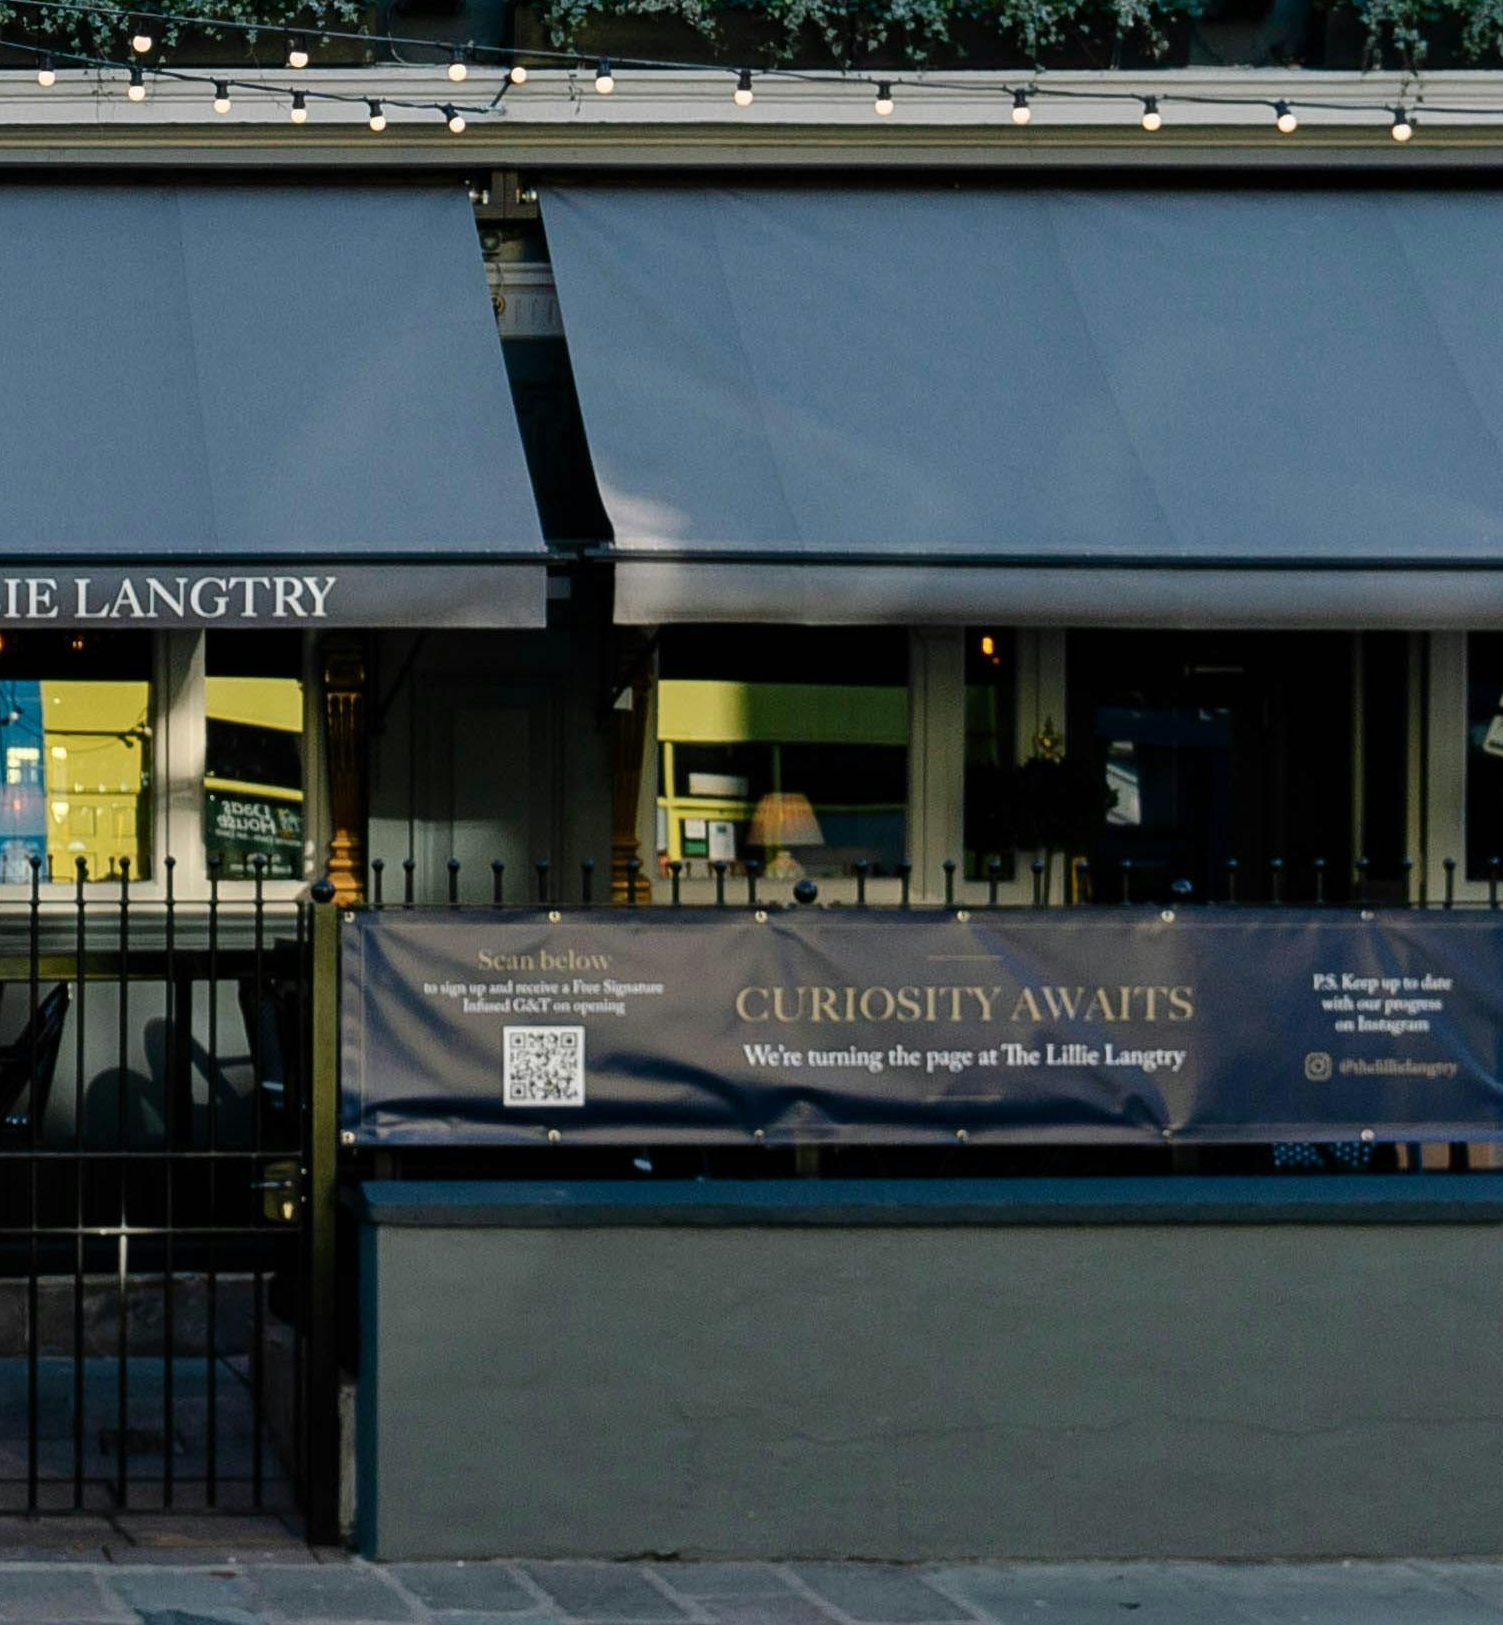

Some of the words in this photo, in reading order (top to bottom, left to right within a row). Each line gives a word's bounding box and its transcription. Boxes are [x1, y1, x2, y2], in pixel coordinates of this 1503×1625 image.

[74, 576, 336, 618] LANGTRY
[478, 949, 535, 971] Scan
[540, 948, 611, 972] below
[423, 982, 439, 995] to
[439, 980, 467, 998] sign
[468, 984, 487, 998] up
[488, 979, 514, 995] and
[572, 978, 601, 995] Free
[602, 979, 664, 998] Signature
[1341, 973, 1380, 995] Keep
[1381, 978, 1402, 995] up
[1402, 977, 1420, 991] to
[1420, 973, 1453, 991] date
[463, 996, 511, 1013] Infused
[512, 997, 552, 1013] G&T
[552, 1001, 572, 1013] on
[572, 998, 626, 1017] opening
[736, 986, 1001, 1022] CURIOSITY
[1011, 986, 1194, 1022] AWAITS
[1321, 994, 1355, 1011] with
[1356, 998, 1382, 1012] our
[1384, 998, 1443, 1016] progress
[1334, 1019, 1356, 1032] on
[1357, 1014, 1431, 1036] Instagram
[743, 1044, 803, 1067] We're
[807, 1045, 884, 1073] turning
[888, 1044, 922, 1067] the
[926, 1050, 974, 1073] page
[978, 1049, 998, 1066] at
[1000, 1042, 1041, 1067] The
[1045, 1043, 1100, 1066] Lillie
[1104, 1043, 1186, 1072] Langtry
